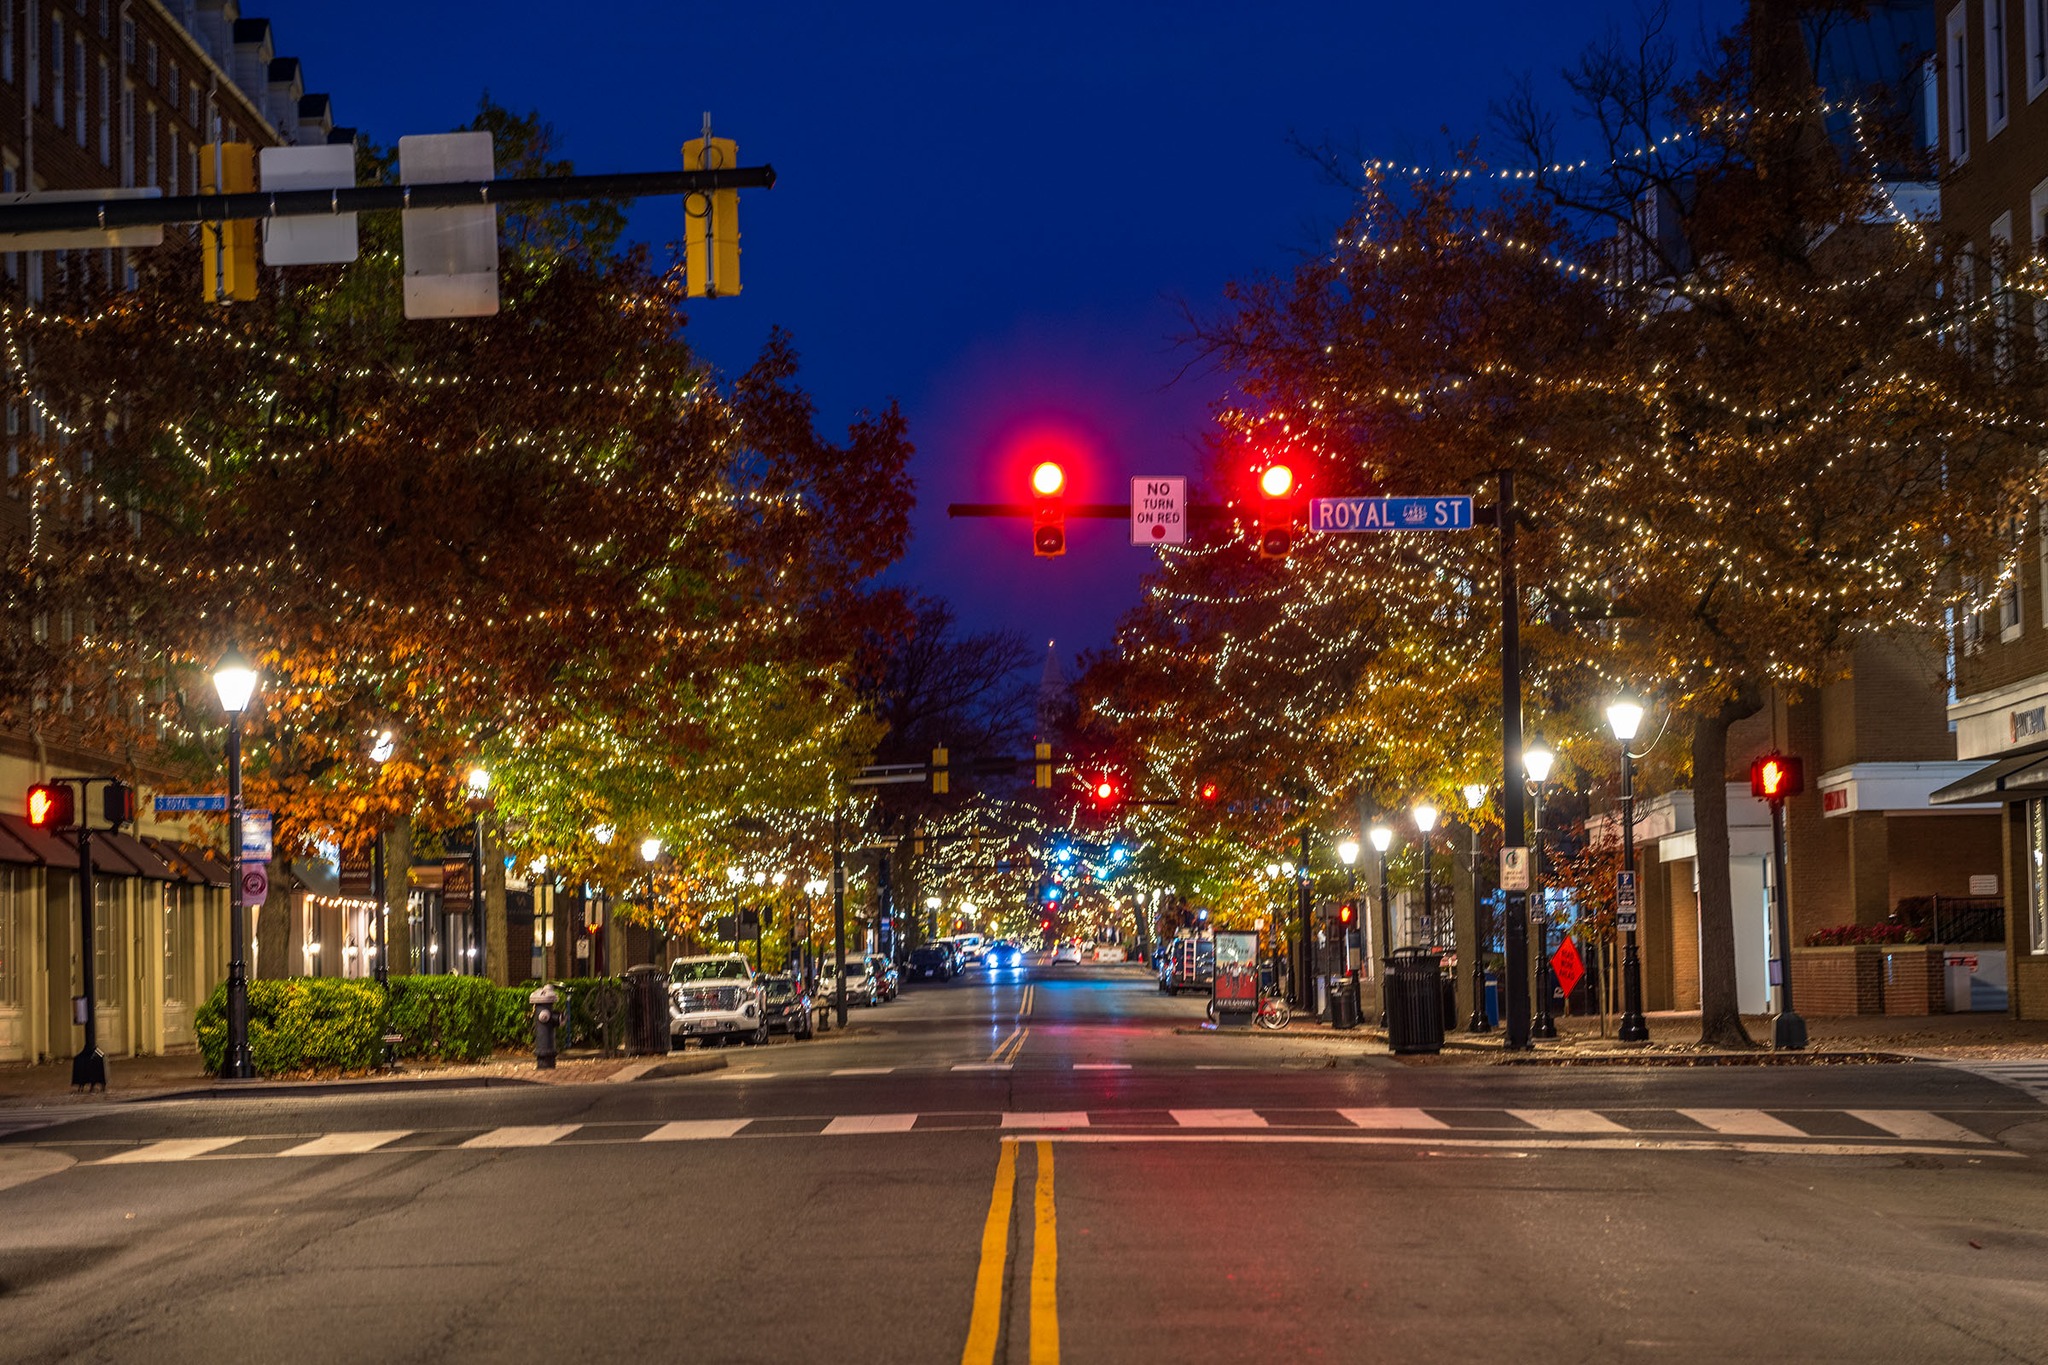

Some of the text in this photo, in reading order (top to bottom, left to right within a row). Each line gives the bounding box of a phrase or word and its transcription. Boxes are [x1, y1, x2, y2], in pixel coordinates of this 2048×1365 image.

[1147, 482, 1170, 496] NO
[1143, 499, 1174, 510] TURN
[1137, 512, 1180, 524] ON RED
[1320, 500, 1463, 528] ROYAL ST
[166, 798, 191, 810] ROYAL
